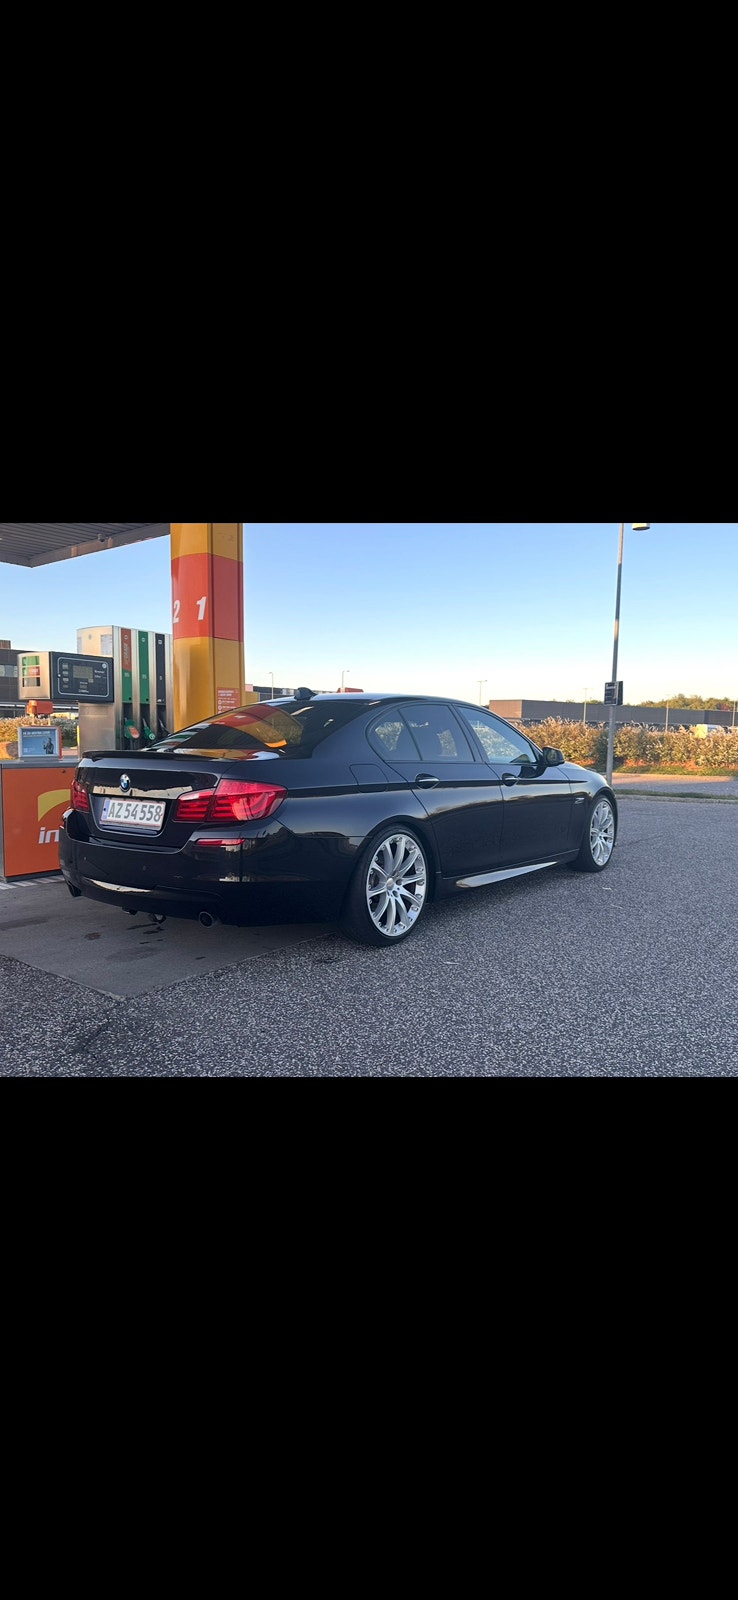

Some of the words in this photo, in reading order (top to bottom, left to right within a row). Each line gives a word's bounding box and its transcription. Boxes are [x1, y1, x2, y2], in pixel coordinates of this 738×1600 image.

[172, 599, 181, 624] 2
[196, 596, 207, 621] 1
[108, 802, 123, 819] AZ
[123, 803, 139, 820] 54
[139, 804, 162, 822] 558
